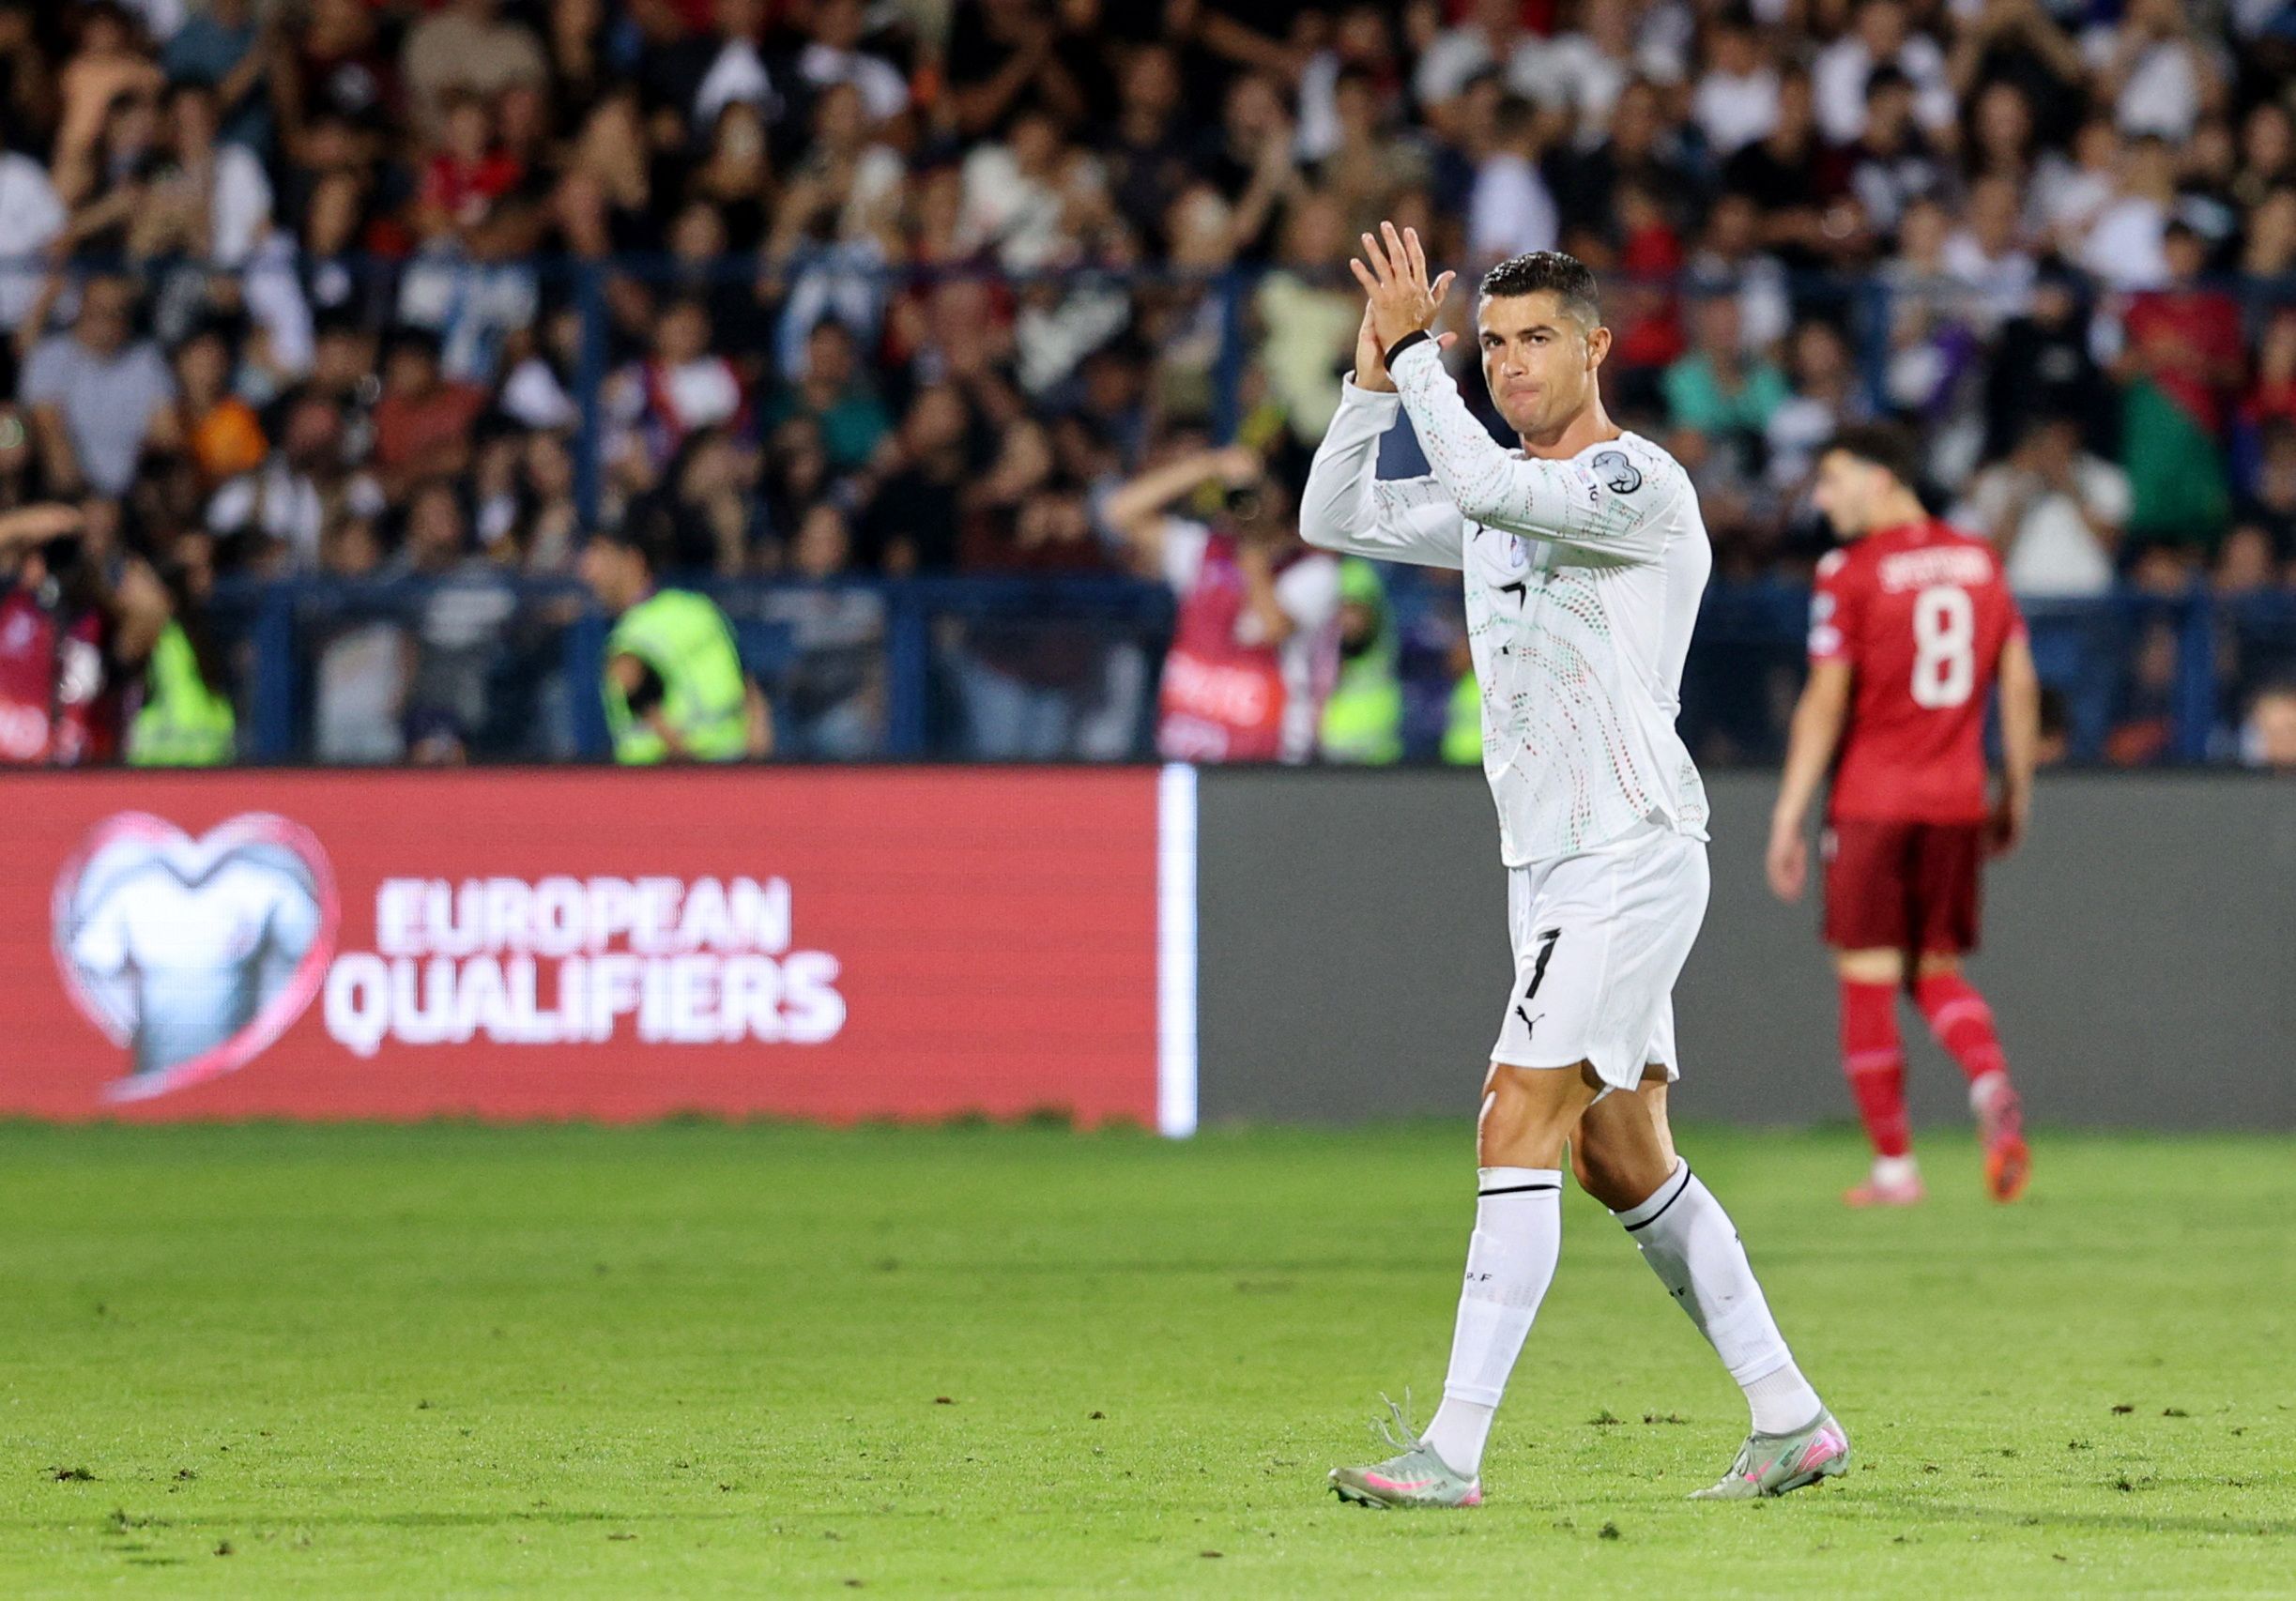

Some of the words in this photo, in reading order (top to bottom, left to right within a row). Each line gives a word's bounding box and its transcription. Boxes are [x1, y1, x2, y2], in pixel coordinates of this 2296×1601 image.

[1912, 586, 1974, 709] 8
[377, 877, 790, 955] EUROPEAN
[325, 952, 846, 1058] QUALIFIERS
[1524, 927, 1562, 999] 7
